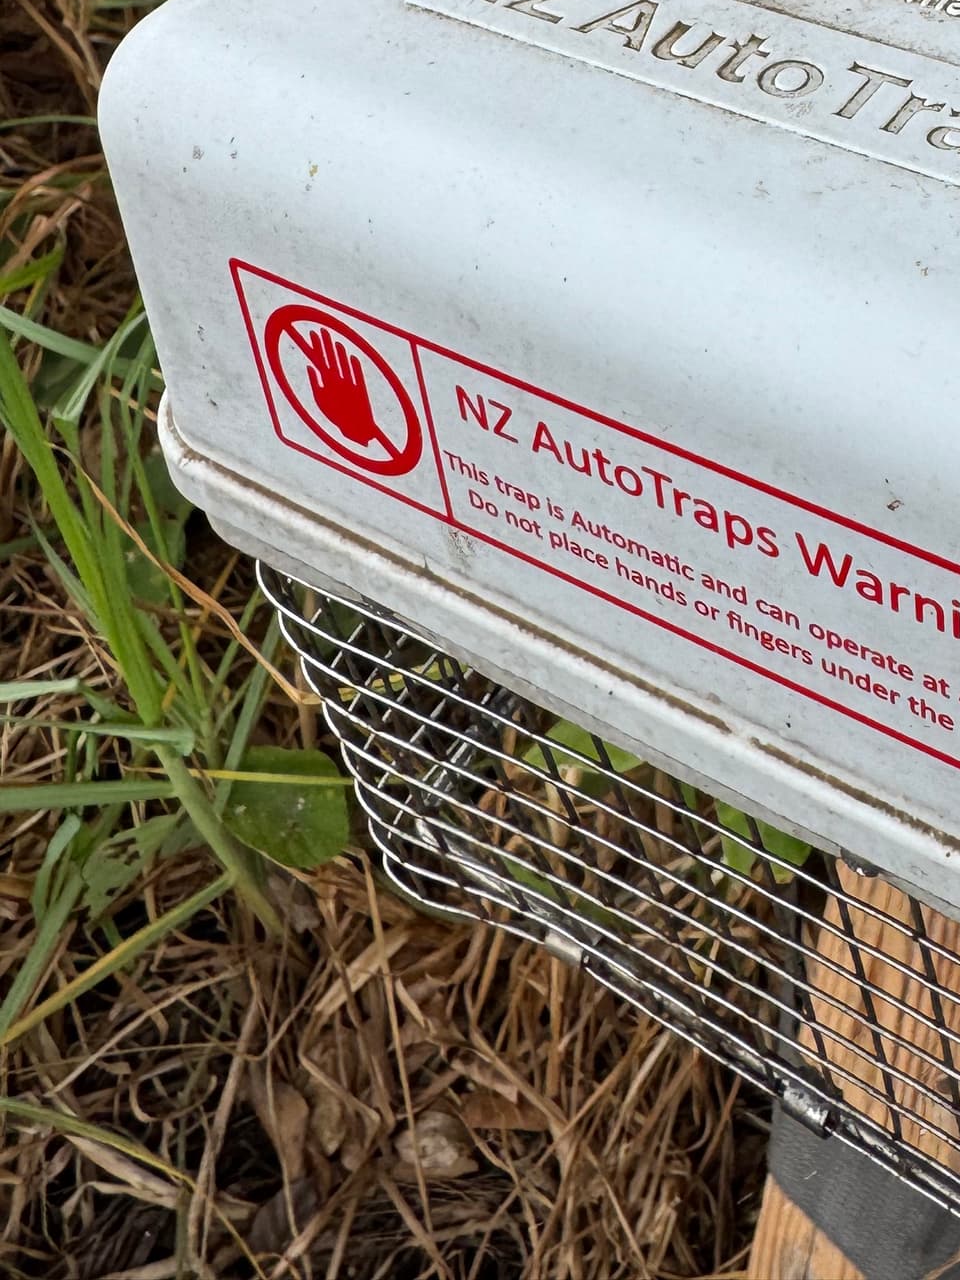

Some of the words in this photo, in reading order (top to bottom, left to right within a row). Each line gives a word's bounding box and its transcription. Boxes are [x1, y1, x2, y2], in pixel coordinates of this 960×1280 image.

[443, 449, 490, 486] This
[494, 476, 541, 510] trap
[546, 497, 565, 522] is
[571, 511, 694, 581] Automatic
[701, 572, 749, 606] and
[756, 598, 800, 631] can
[808, 622, 914, 681] operate
[922, 673, 951, 699] at
[455, 385, 519, 444] NZ
[532, 421, 780, 558] AutoTraps
[468, 489, 499, 518] Do
[505, 509, 543, 540] not
[549, 531, 609, 571] place
[616, 557, 688, 608] hands
[694, 599, 720, 622] or
[726, 609, 813, 666] fingers
[821, 658, 900, 705] under
[907, 696, 954, 732] the
